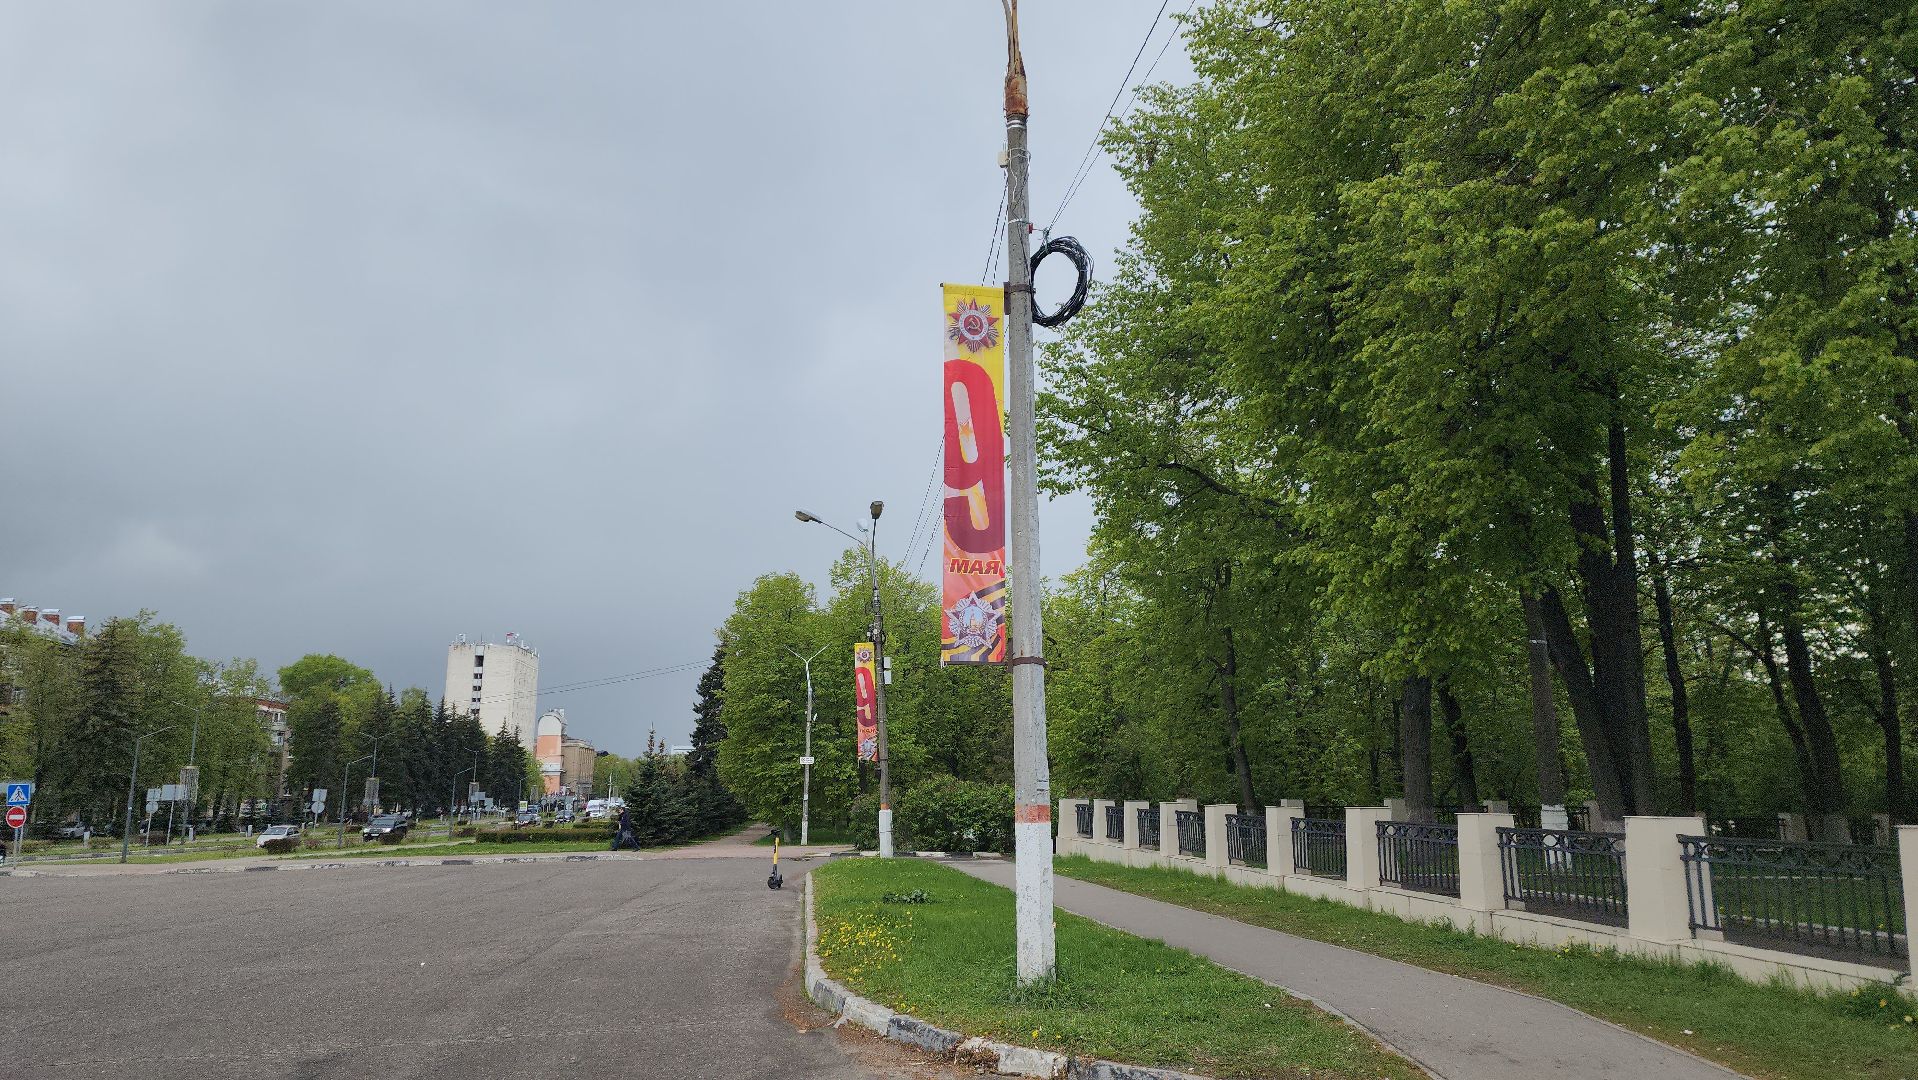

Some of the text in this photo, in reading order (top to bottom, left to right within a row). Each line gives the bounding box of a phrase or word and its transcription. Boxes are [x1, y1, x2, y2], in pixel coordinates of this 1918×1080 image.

[944, 360, 1005, 553] 9
[949, 557, 1001, 575] МАЯ
[856, 667, 876, 727] 9
